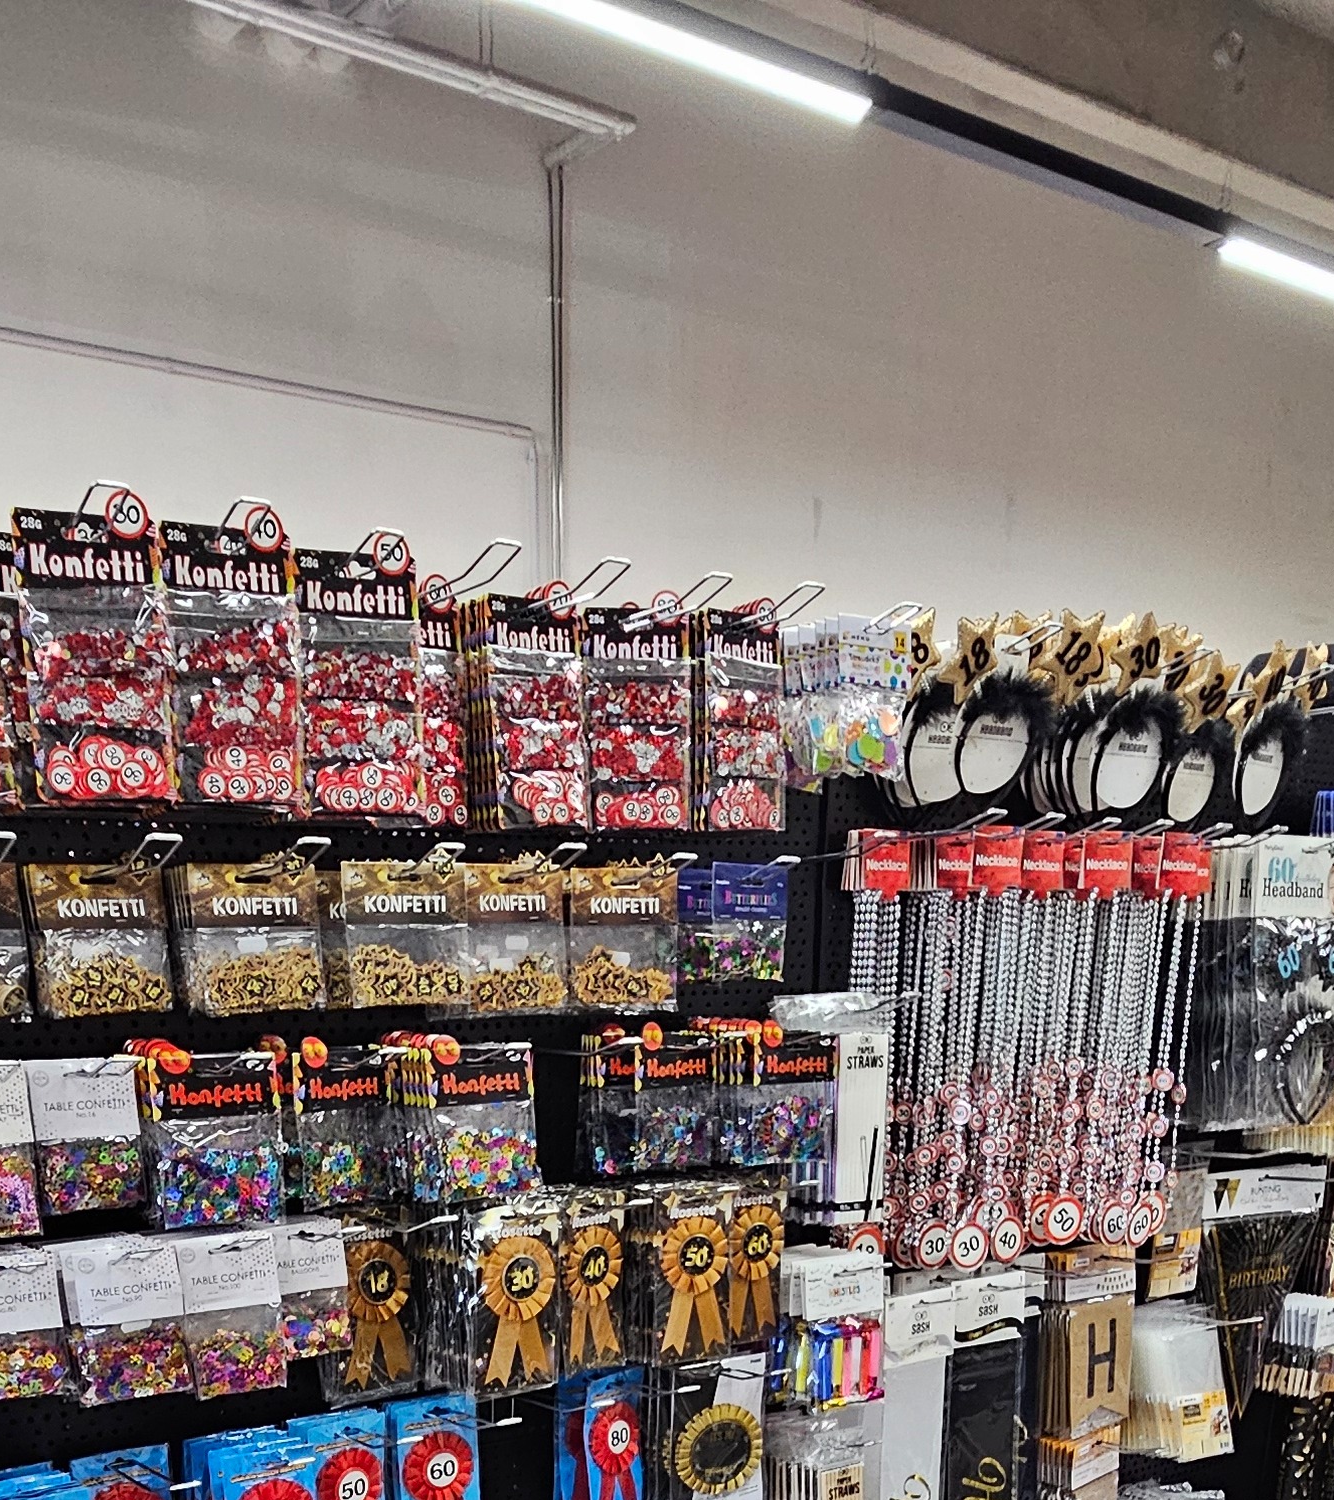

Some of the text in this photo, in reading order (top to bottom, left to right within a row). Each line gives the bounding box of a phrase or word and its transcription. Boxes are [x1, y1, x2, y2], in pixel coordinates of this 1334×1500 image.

[20, 516, 43, 531] 28G
[167, 529, 188, 543] 28G
[29, 544, 145, 584] Konfetti
[300, 556, 319, 569] 28G
[174, 556, 280, 593] Konfetti
[306, 585, 407, 614] Konfetti
[496, 622, 571, 651] Konfetti
[593, 632, 677, 660] Konfetti
[714, 634, 774, 663] Konfetti
[866, 858, 908, 874] Necklace
[976, 853, 1019, 869] Necklace
[1023, 858, 1061, 873] Necklace
[1087, 858, 1129, 873] Necklace
[1162, 858, 1197, 873] Necklace
[1267, 856, 1295, 883] 60
[1262, 877, 1325, 899] Headband
[57, 898, 146, 919] KONFETTI
[213, 896, 299, 917] KONFETTI
[363, 894, 447, 914] KONFETTI
[479, 893, 546, 914] KONFETTI
[590, 897, 660, 916] KONFETTI
[646, 1057, 707, 1079] Konfetti
[766, 1055, 828, 1075] Konfetti
[846, 1054, 885, 1071] STRAWS
[309, 1077, 379, 1100] Konfetti
[441, 1073, 520, 1097] Konfetti
[43, 1101, 74, 1112] TABLE
[1054, 1207, 1075, 1232] 50
[1133, 1215, 1151, 1234] 60
[747, 1235, 770, 1255] 60
[926, 1237, 946, 1255] 30
[959, 1236, 980, 1258] 30
[999, 1231, 1018, 1250] 40
[684, 1245, 710, 1266] 50
[584, 1259, 606, 1278] 40
[1228, 1264, 1291, 1289] BIRTHDAY
[191, 1275, 219, 1286] TABLE
[368, 1270, 389, 1293] 18
[510, 1268, 536, 1291] 30
[90, 1286, 120, 1298] TABLE
[1087, 1318, 1117, 1398] H
[610, 1425, 630, 1447] 80
[429, 1459, 457, 1483] 60
[340, 1476, 369, 1500] 50
[827, 1482, 861, 1500] STRAWS
